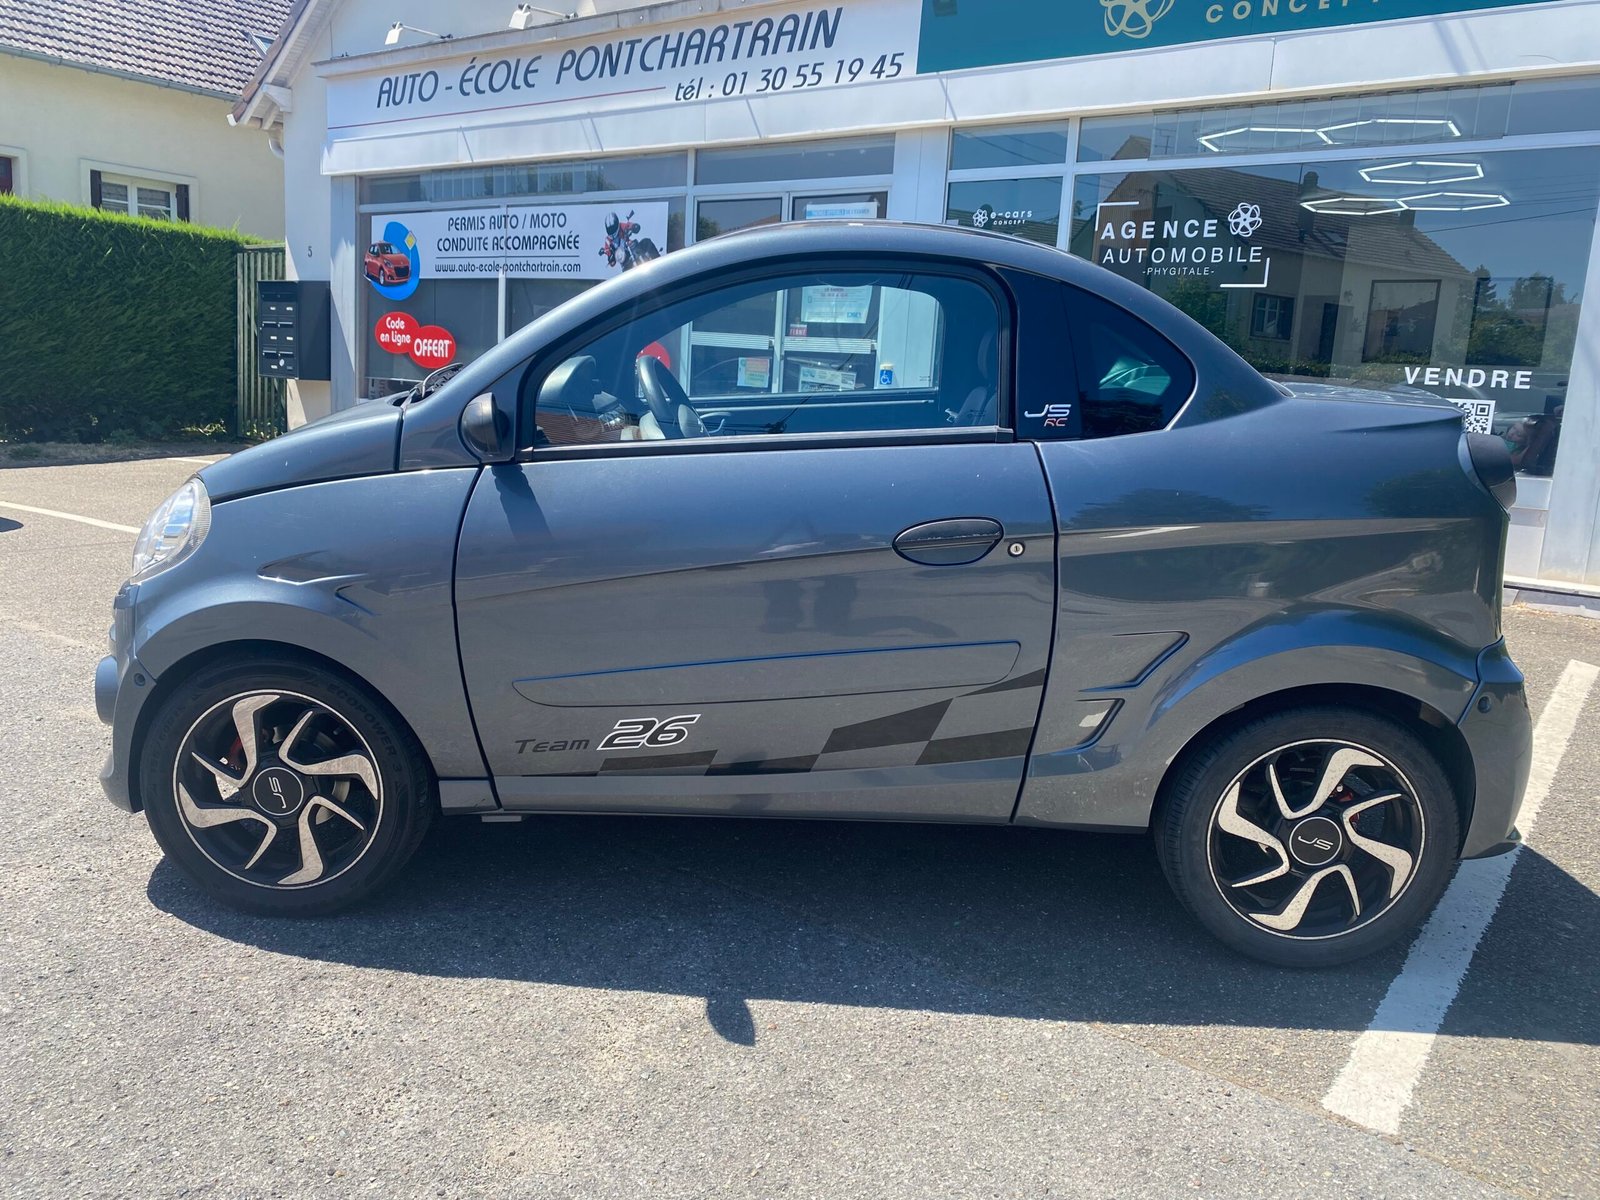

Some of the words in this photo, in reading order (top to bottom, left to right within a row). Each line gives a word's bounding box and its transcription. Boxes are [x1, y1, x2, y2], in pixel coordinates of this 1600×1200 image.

[1205, 0, 1379, 23] CONCE
[377, 70, 439, 108] AUTO
[459, 55, 543, 97] ÉCOLE
[556, 7, 844, 84] PONTCHARTRAIN
[675, 77, 703, 101] tél
[722, 72, 748, 96] 01
[756, 66, 788, 92] 30
[793, 62, 825, 88] 55
[835, 57, 865, 83] 19
[870, 52, 905, 79] 45
[448, 215, 486, 231] PERMIS
[489, 214, 519, 230] AUTO
[530, 212, 567, 228] MOTO
[990, 210, 1033, 219] e-cars
[1100, 219, 1218, 240] AGENCE
[437, 237, 488, 251] CONDUITE
[492, 231, 580, 251] ACCOMPAGNÉE
[307, 246, 313, 257] 5
[1102, 246, 1263, 264] AUTOMOBILE
[435, 260, 581, 274] www.auto-ecole-pontchartrain.com
[386, 316, 405, 329] Code
[380, 333, 390, 342] en
[391, 331, 411, 346] Ligne
[1404, 366, 1533, 389] VENDRE
[1024, 404, 1071, 418] JS
[1044, 418, 1068, 427] RC
[596, 714, 702, 750] 26
[1297, 835, 1334, 850] JS
